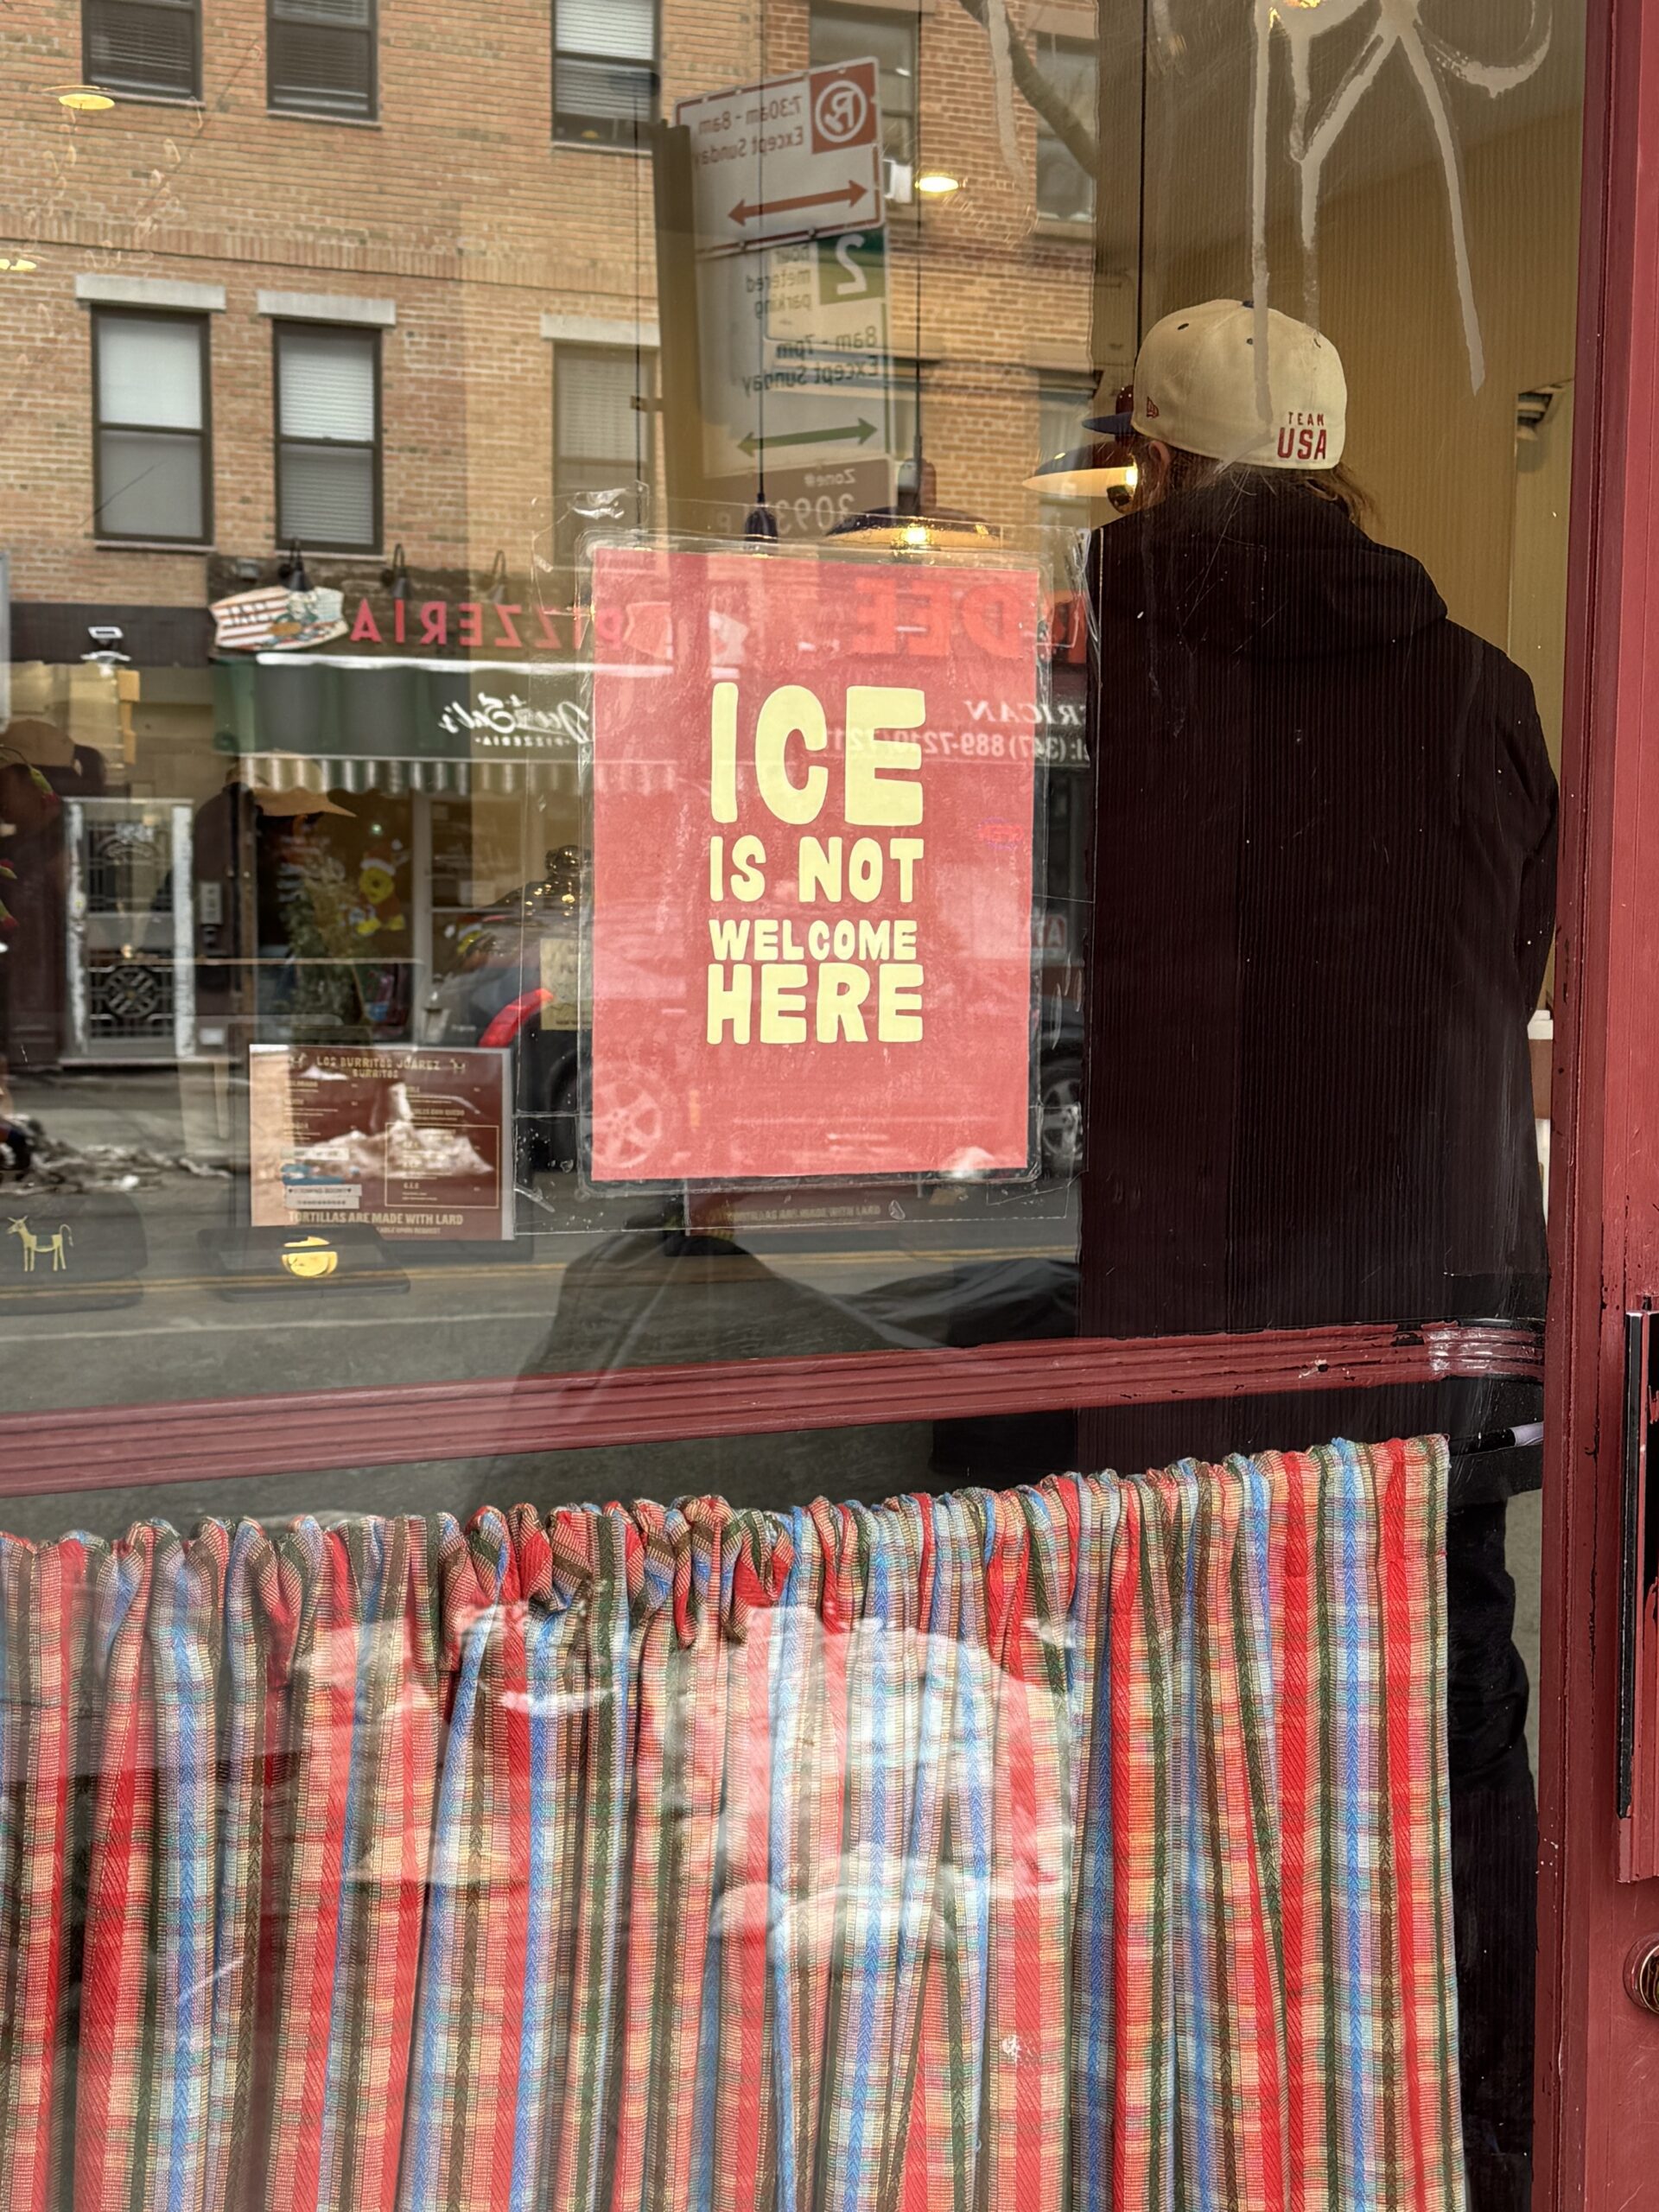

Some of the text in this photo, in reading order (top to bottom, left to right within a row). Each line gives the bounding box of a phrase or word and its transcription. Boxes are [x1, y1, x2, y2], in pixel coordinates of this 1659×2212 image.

[1287, 411, 1325, 426] TEAM
[1277, 427, 1327, 460] USA
[709, 681, 926, 827] ICE
[709, 835, 925, 904] IS NOT
[708, 918, 918, 962] WELCOME
[706, 962, 925, 1046] HERE
[316, 1056, 336, 1067] LOS
[340, 1057, 392, 1069] BURRITOS
[288, 1210, 464, 1225] TORTILLAS ARE MADE WITH LARD
